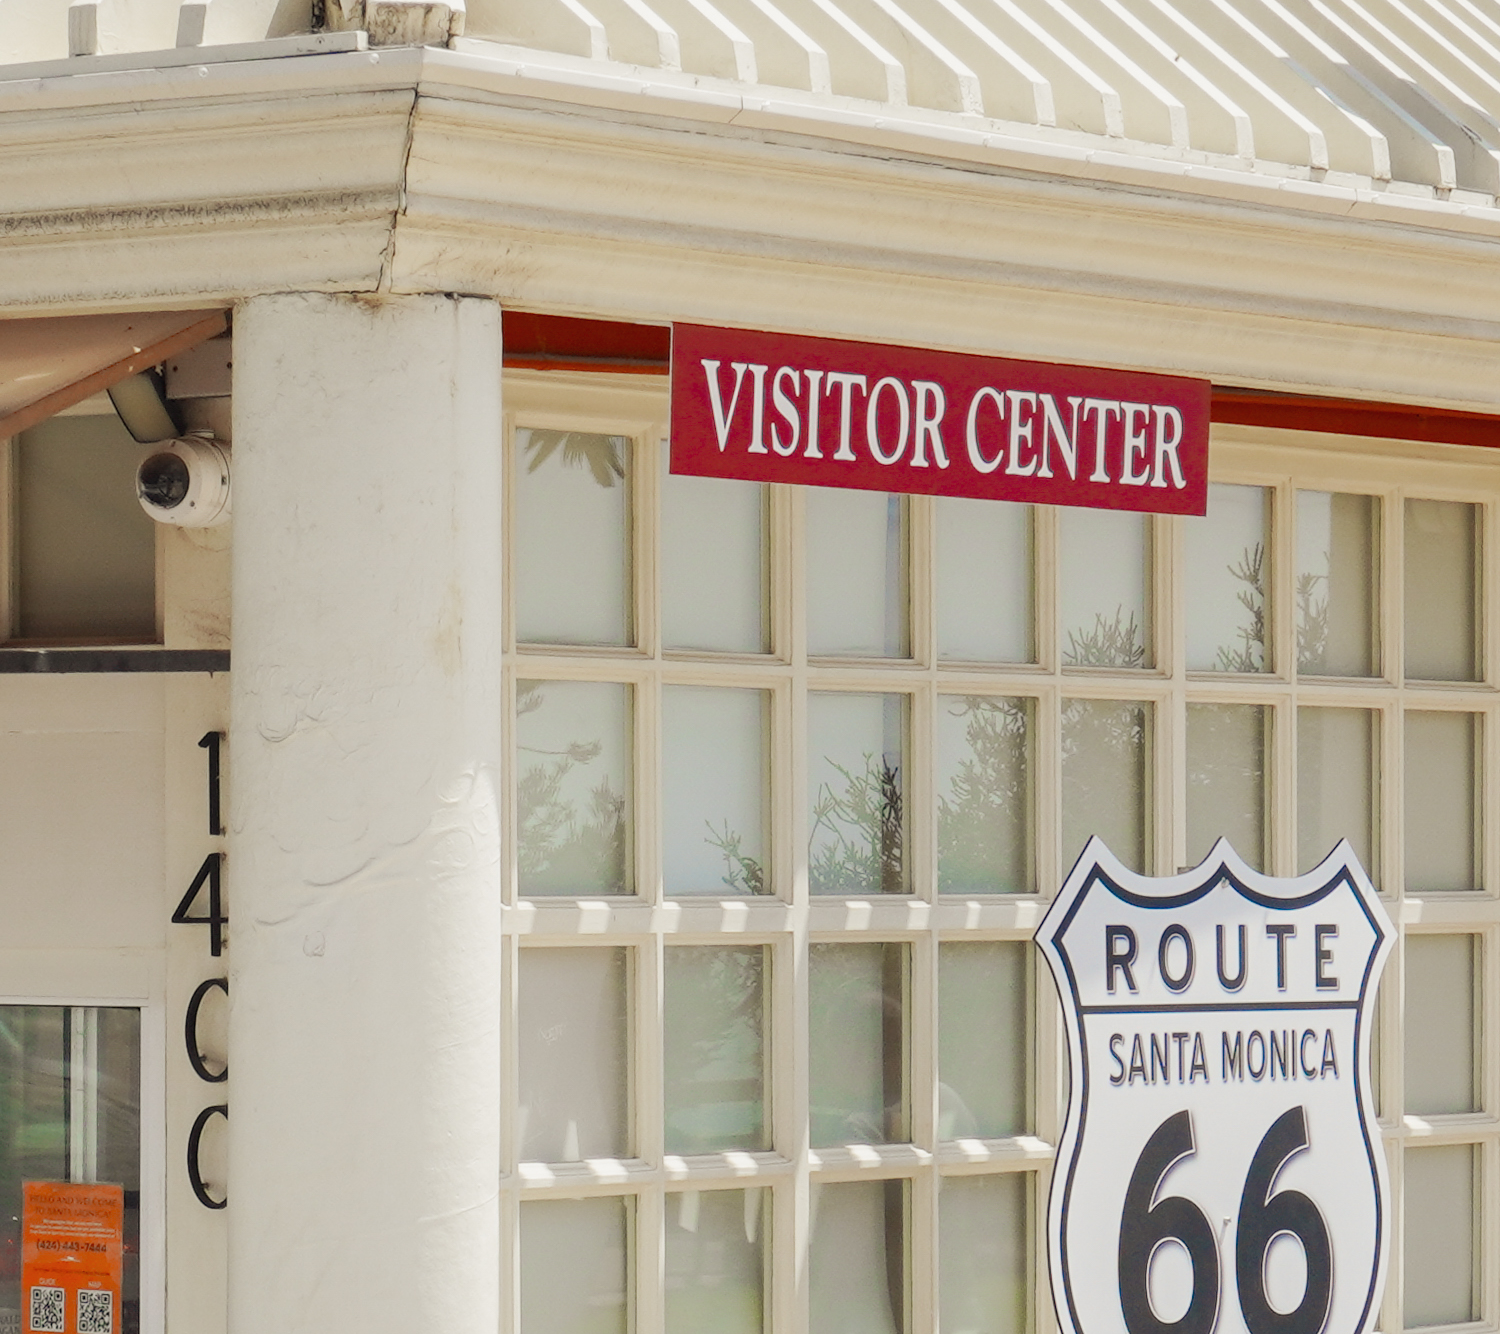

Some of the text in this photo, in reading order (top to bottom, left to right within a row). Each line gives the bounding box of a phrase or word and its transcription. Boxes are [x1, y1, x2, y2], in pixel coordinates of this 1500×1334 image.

[701, 358, 1187, 490] VISITOR CENTER
[1104, 921, 1341, 995] ROUTE
[1109, 1028, 1340, 1088] SANTA MONICA
[29, 1194, 55, 1204] HELLO
[56, 1196, 74, 1205] AND
[36, 1239, 61, 1252] (424)
